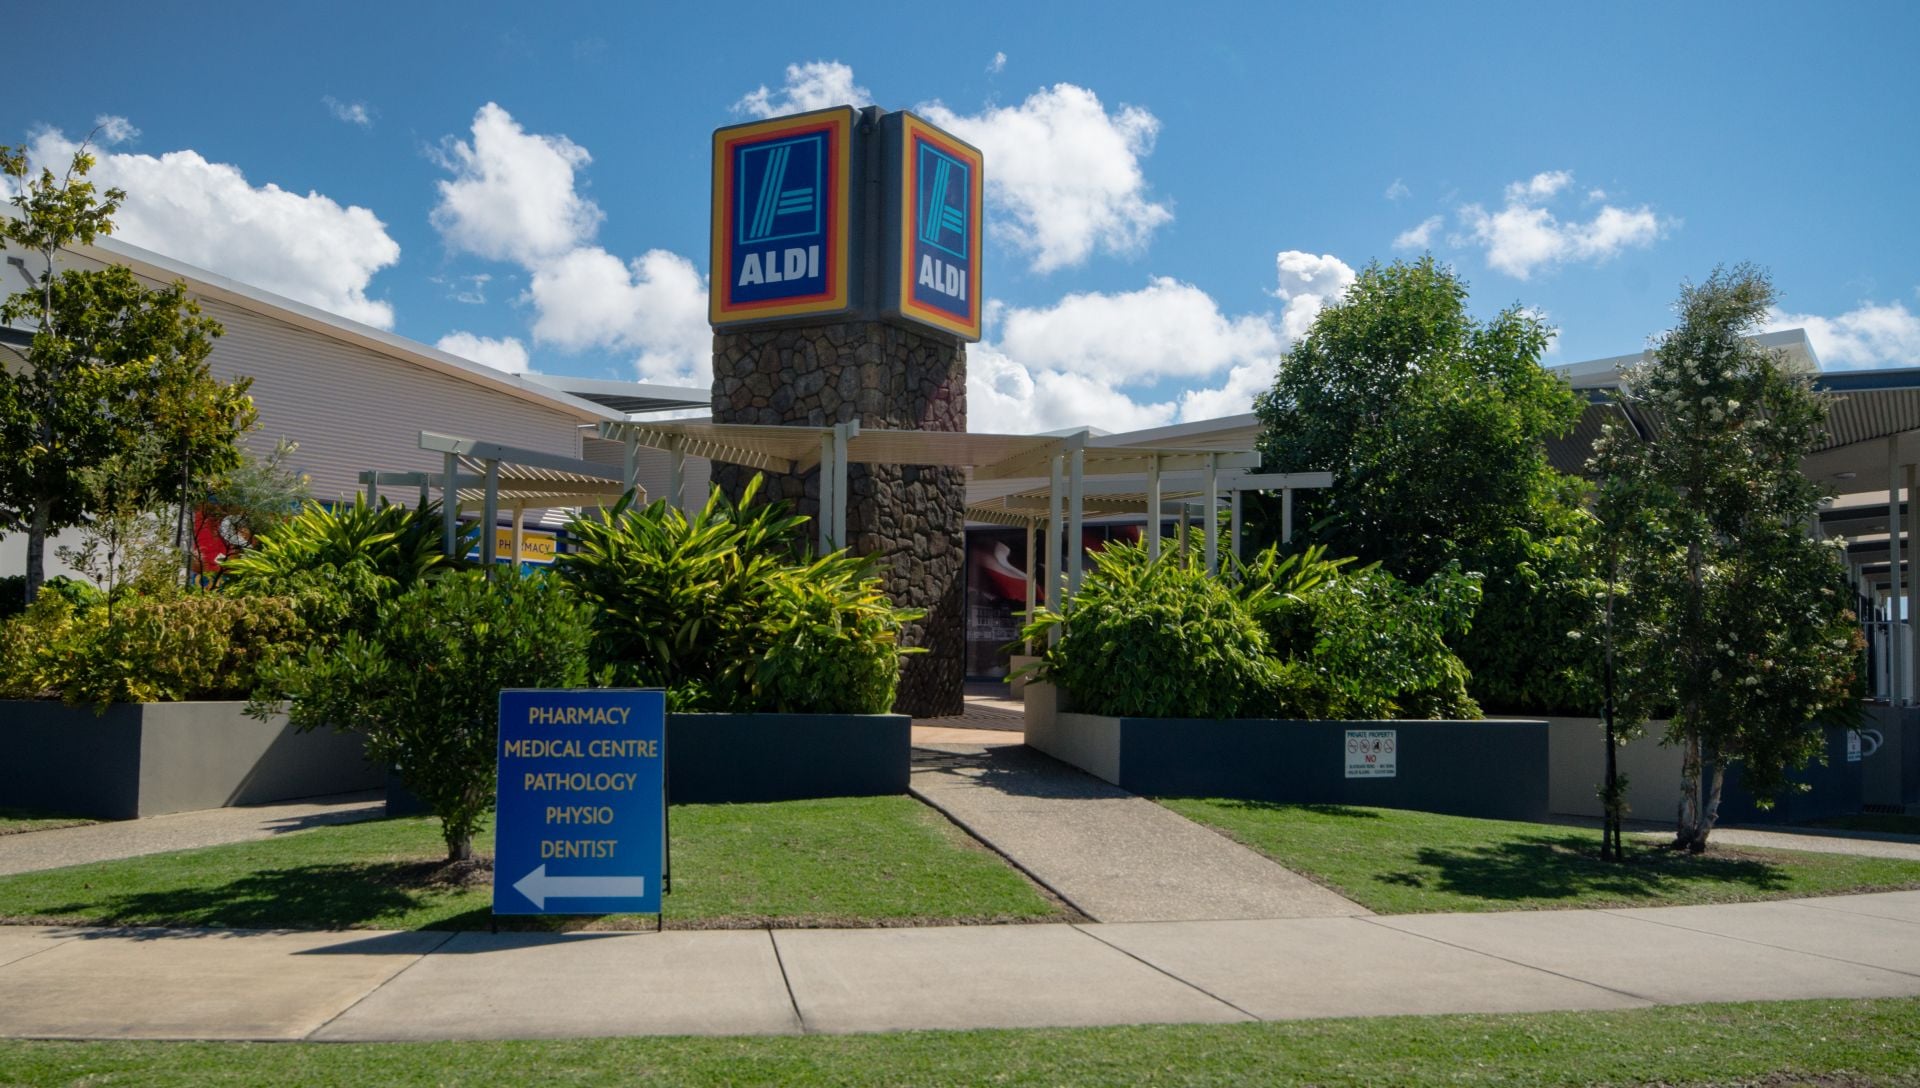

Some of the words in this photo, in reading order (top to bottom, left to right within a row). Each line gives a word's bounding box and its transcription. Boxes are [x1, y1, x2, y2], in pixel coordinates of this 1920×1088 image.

[738, 245, 819, 286] ALDI
[919, 254, 966, 300] ALDI
[498, 539, 550, 554] PHMACY
[528, 707, 631, 724] PHARMACY
[504, 740, 584, 758] MEDICAL
[588, 740, 658, 757] CENTRE
[1365, 754, 1377, 763] NO
[524, 773, 637, 791] PATHOLOGY
[546, 806, 614, 824] PHYSIO
[541, 840, 617, 858] DENTIST
